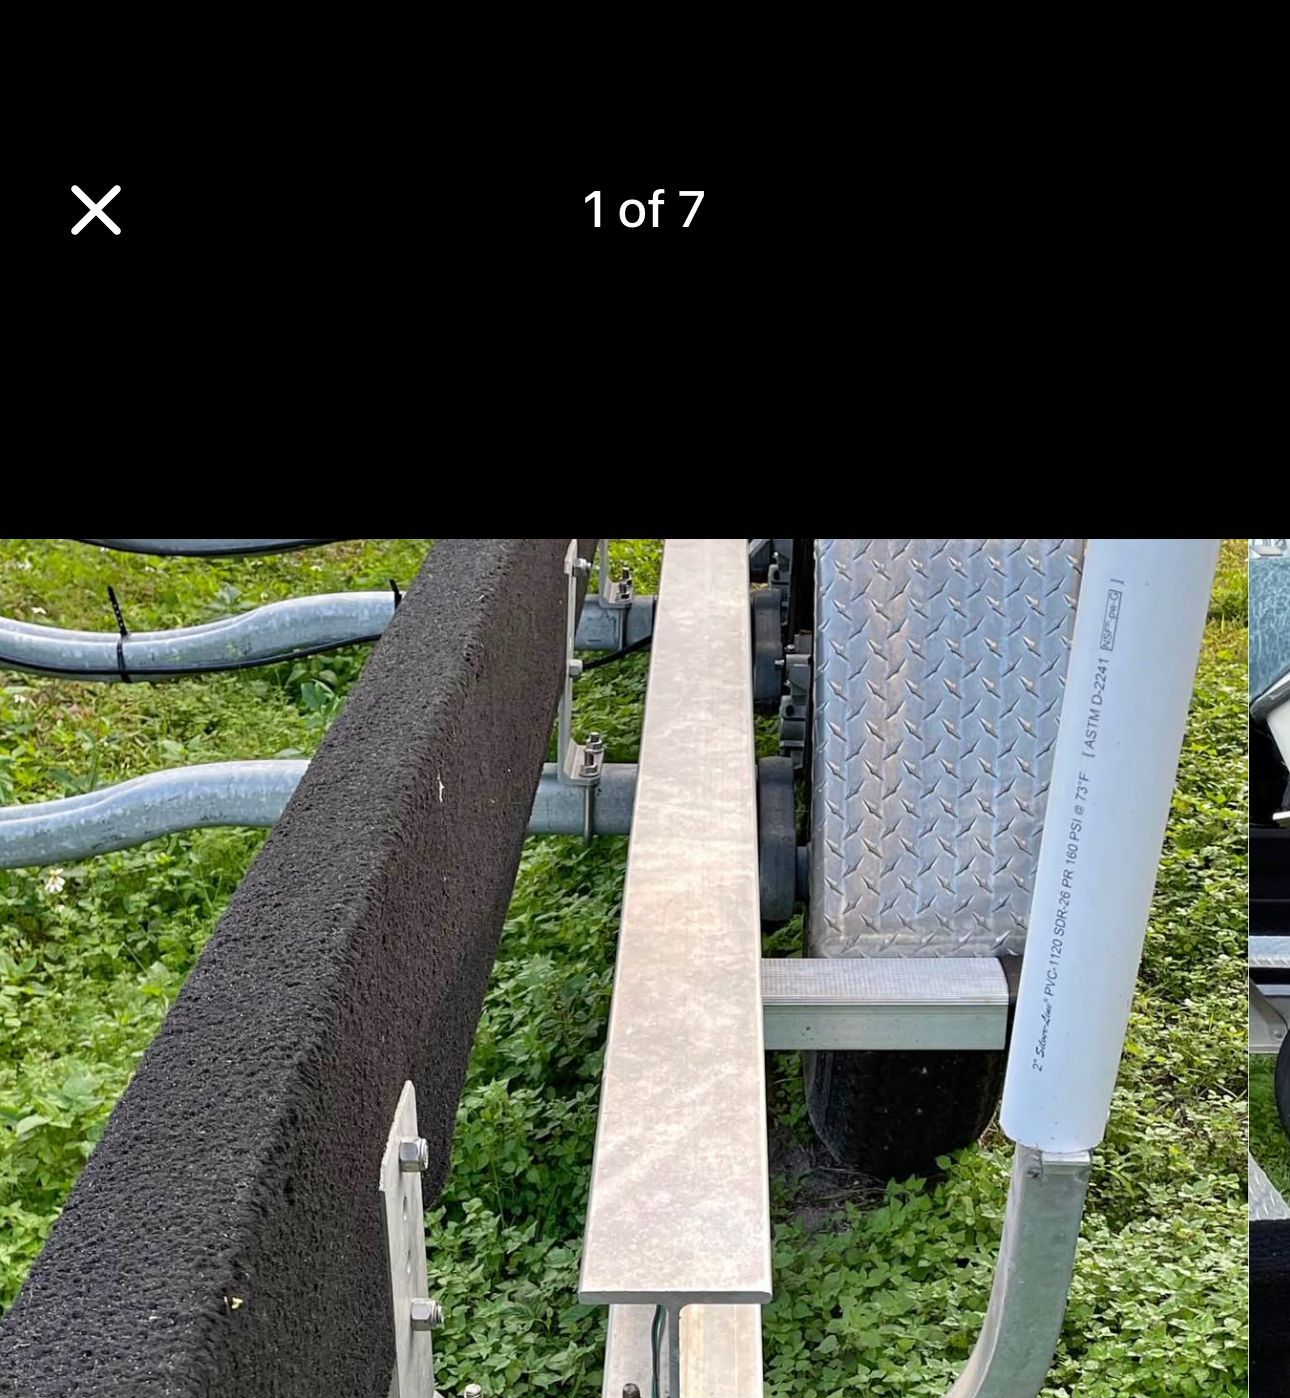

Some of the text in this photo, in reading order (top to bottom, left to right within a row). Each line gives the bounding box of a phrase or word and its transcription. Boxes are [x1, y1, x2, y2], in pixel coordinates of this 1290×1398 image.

[1091, 658, 1109, 706] D-2241
[1084, 708, 1101, 750] ASTM
[1075, 770, 1090, 801] 73°F
[1074, 804, 1085, 816] @
[1069, 818, 1082, 841] PSI
[1065, 843, 1078, 864] 160
[1062, 869, 1075, 888] PR
[1054, 890, 1071, 937] SDR-26
[1044, 938, 1063, 997] PVC-1120
